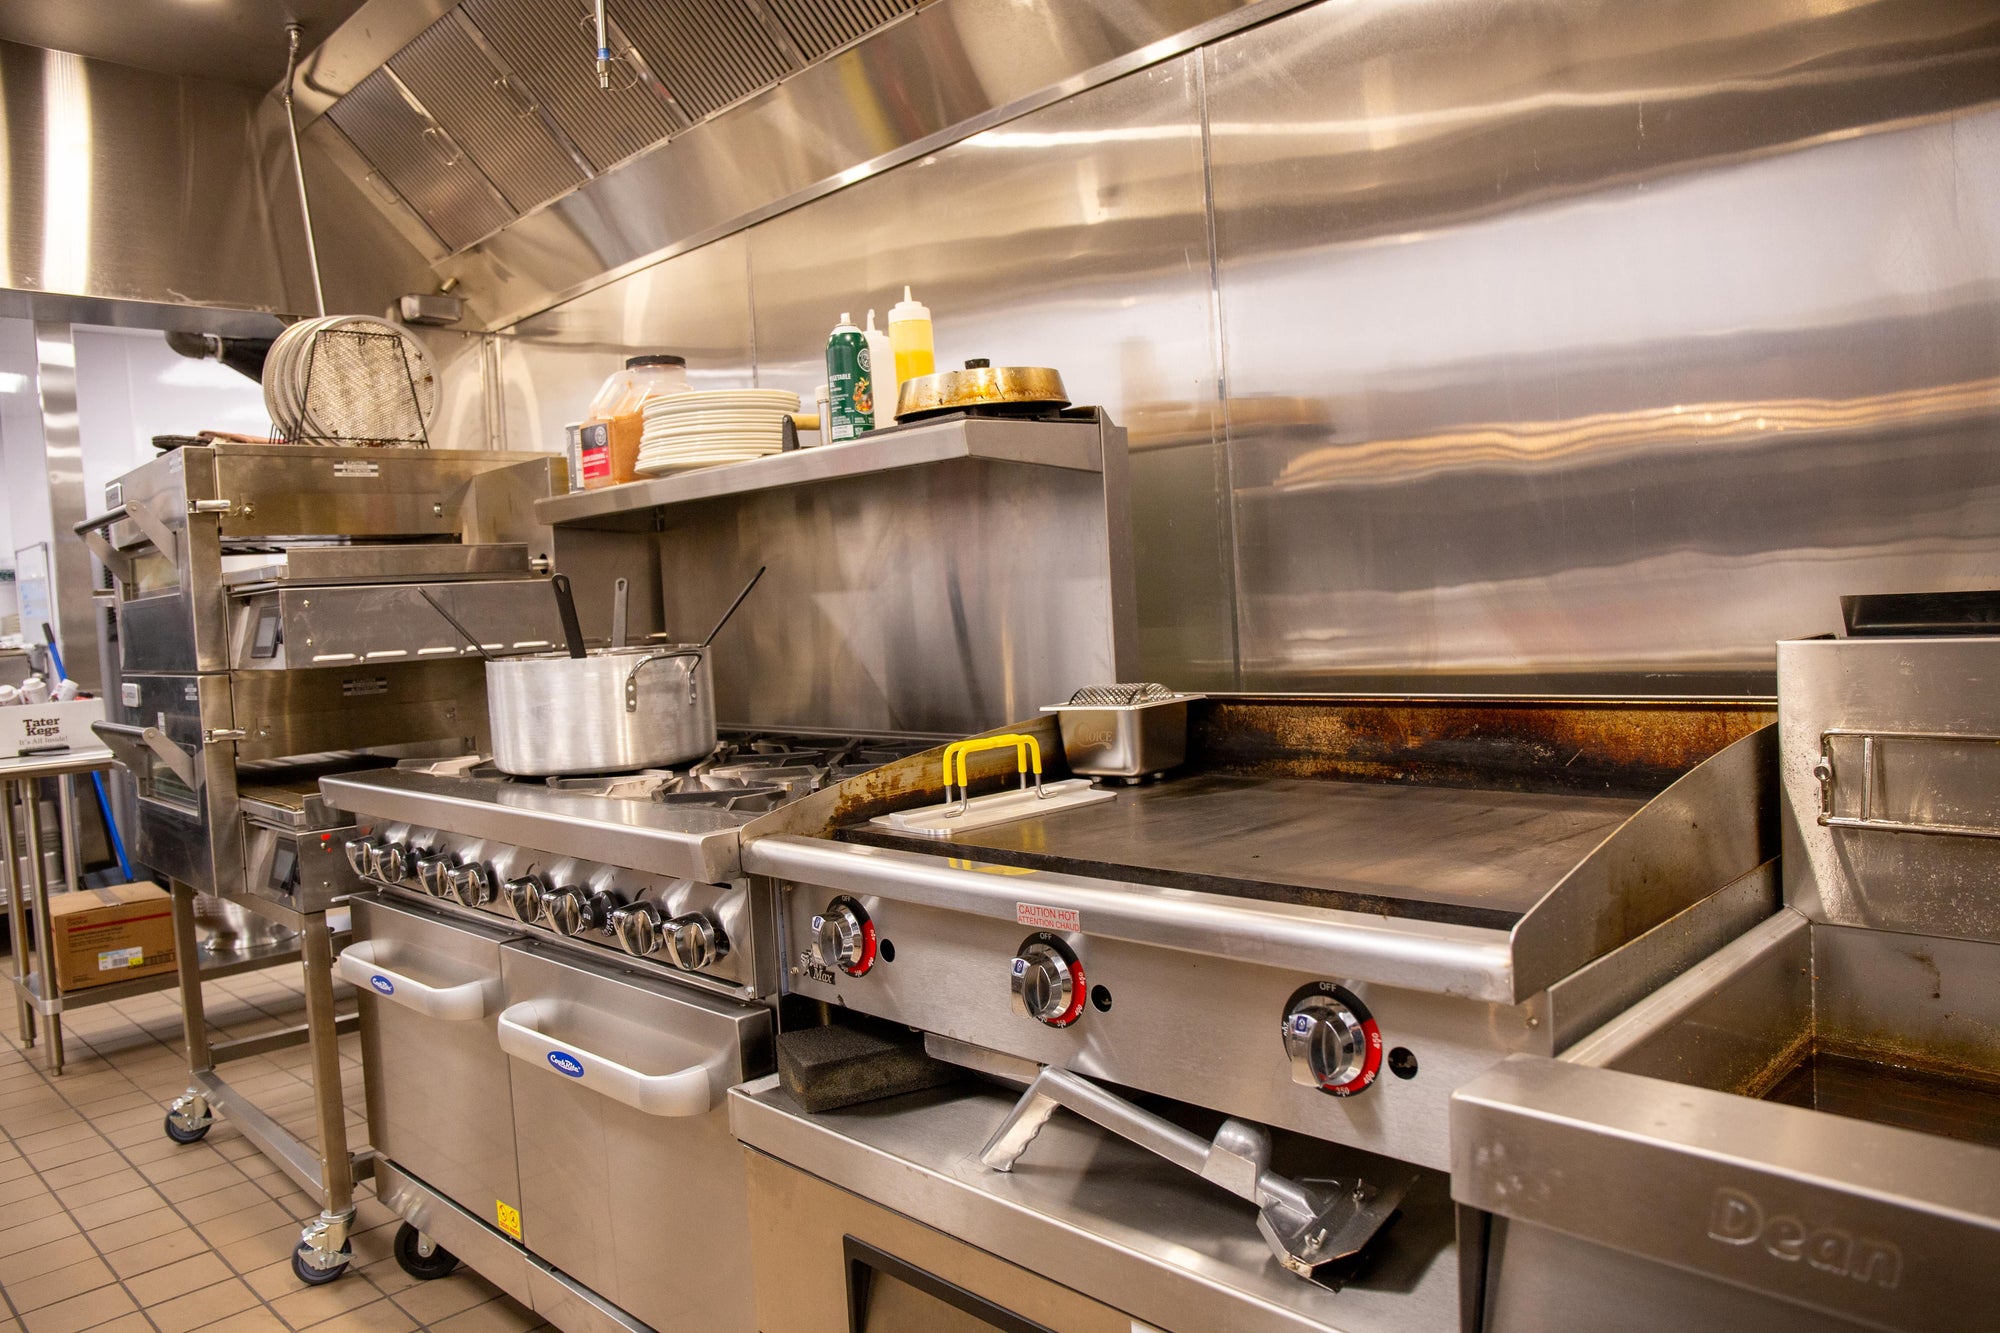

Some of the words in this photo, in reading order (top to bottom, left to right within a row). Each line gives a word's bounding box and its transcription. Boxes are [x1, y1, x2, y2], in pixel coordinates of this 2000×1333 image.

[23, 718, 60, 728] Tater
[26, 726, 60, 736] Kegs
[1018, 904, 1057, 919] CAUTION
[1058, 911, 1077, 922] HOT
[1018, 915, 1055, 928] ATTENTION
[1055, 920, 1080, 932] CHAUD
[1040, 932, 1053, 941] OFF
[812, 966, 833, 984] Max
[1078, 972, 1086, 986] 450
[1319, 982, 1337, 992] OFF
[1371, 1033, 1381, 1049] 450
[550, 1054, 580, 1072] CookRite
[1363, 1070, 1375, 1084] 400
[1336, 1086, 1350, 1095] 350
[1706, 1186, 1903, 1290] Dean
